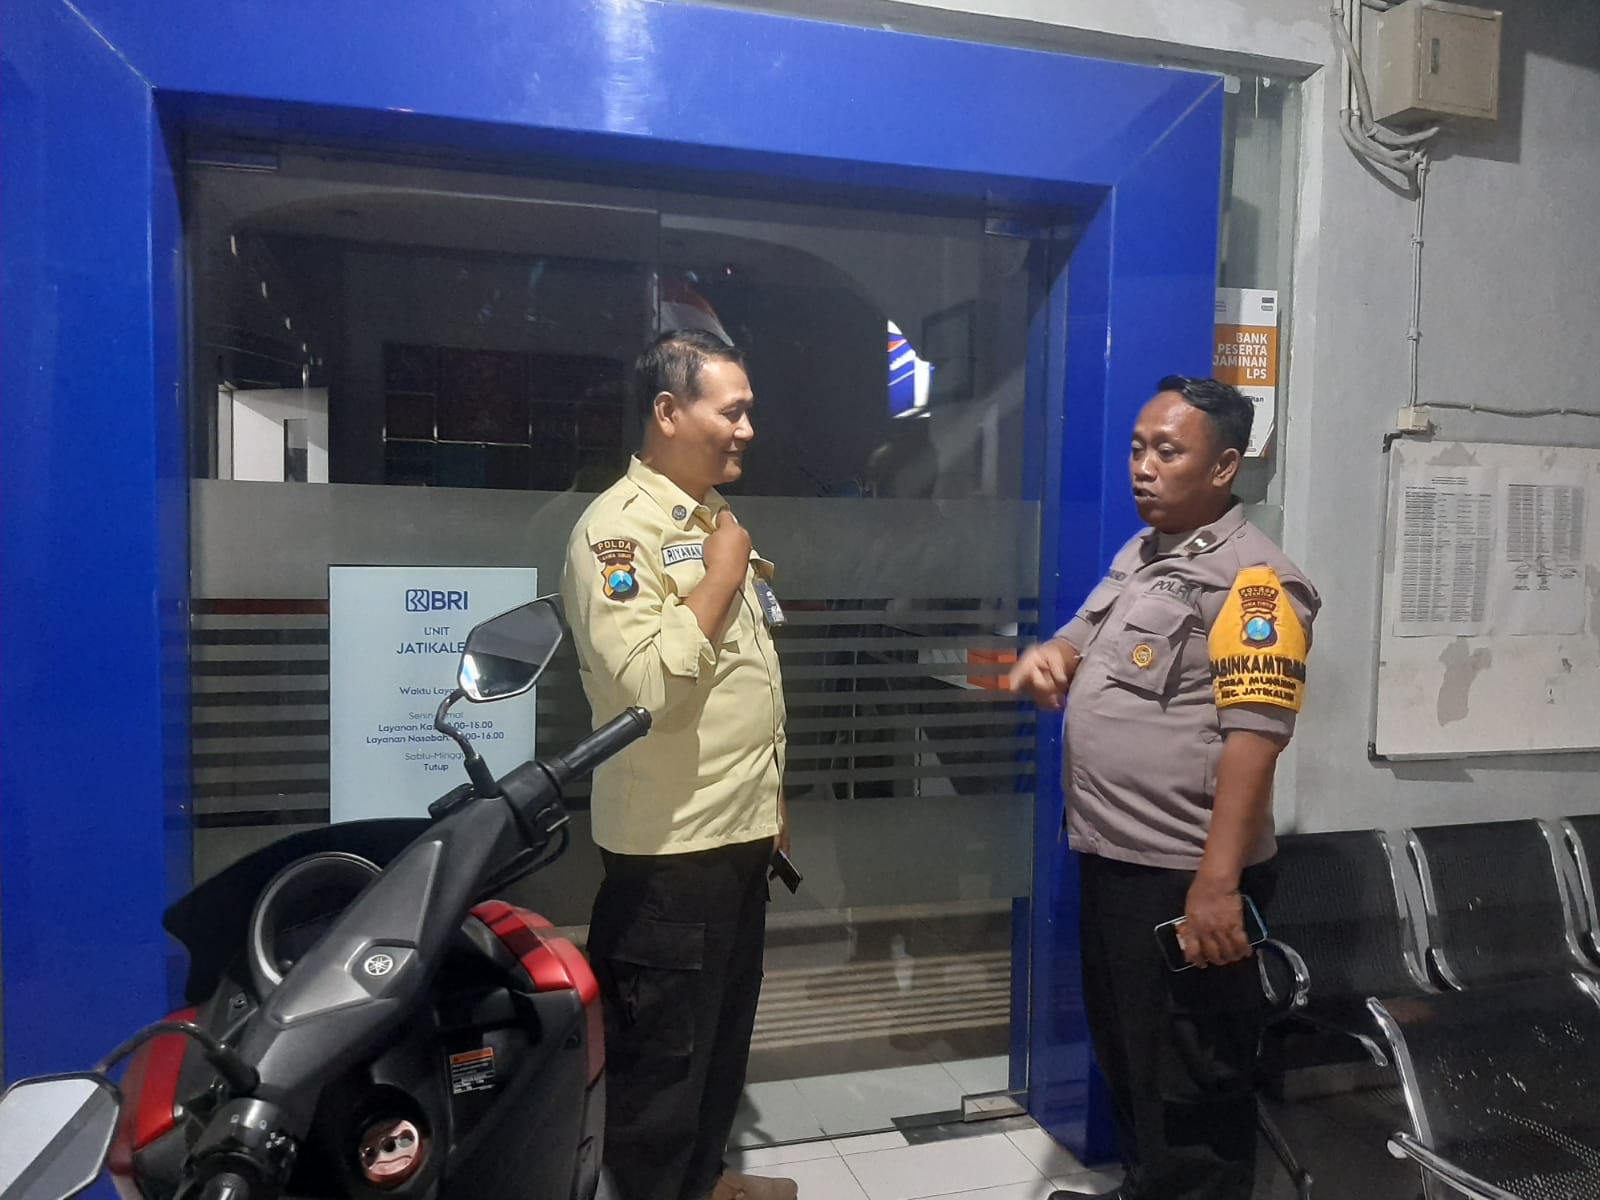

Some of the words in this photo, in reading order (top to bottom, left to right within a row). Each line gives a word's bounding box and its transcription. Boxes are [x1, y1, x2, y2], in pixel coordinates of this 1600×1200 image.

[1236, 333, 1268, 345] BANK
[1218, 344, 1267, 356] PESERTA
[1246, 368, 1267, 379] LPS
[598, 540, 632, 551] POLDA
[431, 590, 468, 610] BRI
[424, 627, 450, 636] UNIT
[396, 641, 466, 654] JATIKALE
[399, 687, 431, 695] Waktu
[433, 687, 456, 697] Laya
[378, 724, 418, 733] Layanan
[366, 736, 406, 744] Layanan
[424, 763, 449, 771] Tutup
